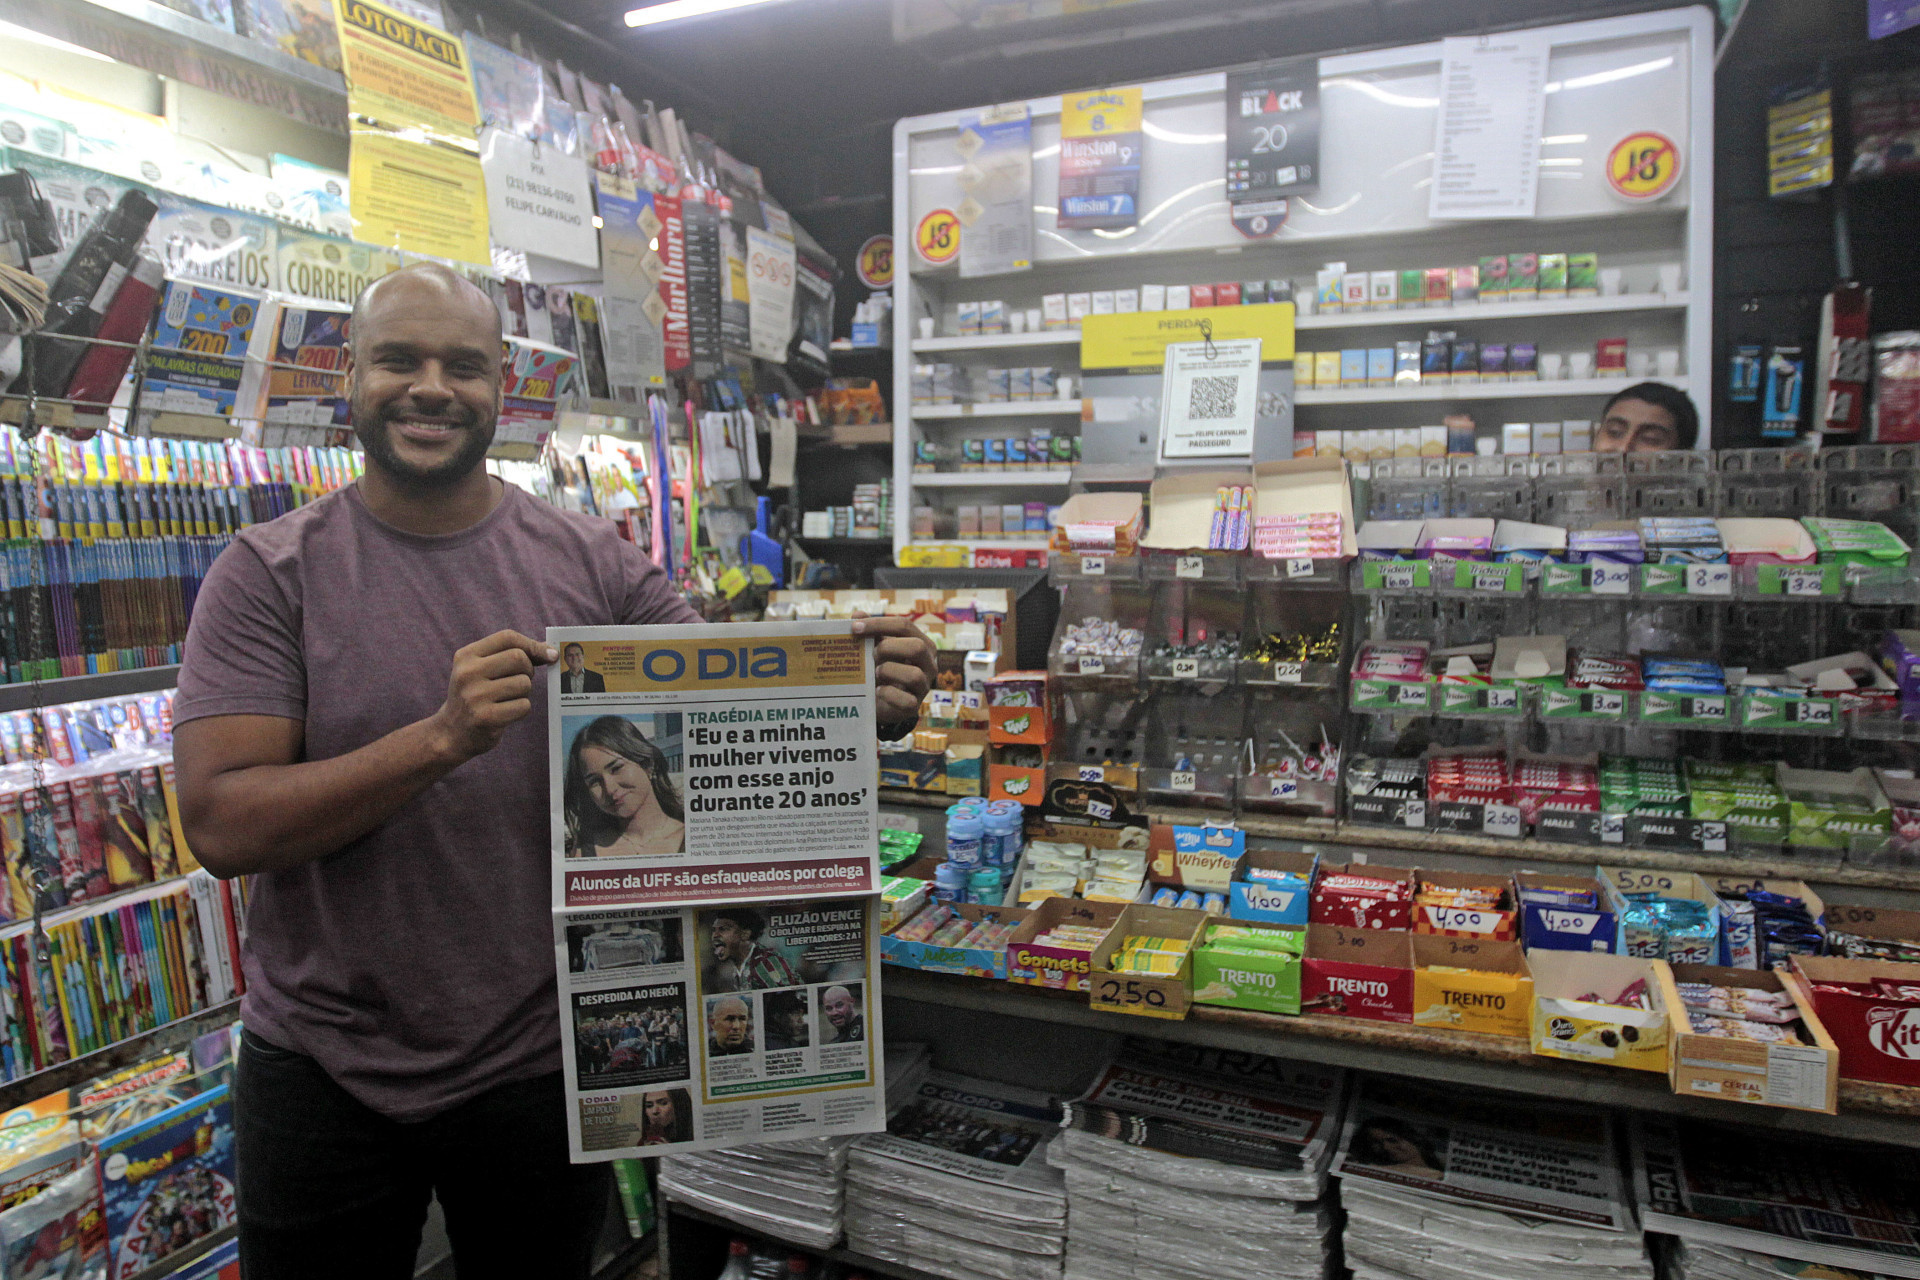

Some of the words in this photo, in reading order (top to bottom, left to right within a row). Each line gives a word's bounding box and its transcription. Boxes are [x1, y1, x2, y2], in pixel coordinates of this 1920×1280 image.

[1251, 124, 1288, 155] 20
[1061, 139, 1118, 158] Winston
[1121, 147, 1132, 165] 9
[1065, 199, 1110, 214] Winston
[1112, 194, 1125, 214] 7
[505, 196, 533, 215] FELIPE
[535, 203, 582, 227] CARVALHO
[659, 216, 688, 332] Marlboro
[151, 355, 195, 374] PALAVRAS
[196, 361, 241, 381] CRUZADAS
[1216, 428, 1247, 436] CARVALHO
[1189, 439, 1231, 448] PAGSEGURO
[1377, 563, 1418, 575] Trident
[1469, 563, 1511, 576] Trident
[1546, 571, 1578, 581] Trident
[1593, 569, 1629, 586] 8.00
[1646, 572, 1678, 581] Trident
[1694, 569, 1729, 586] 8.00
[642, 648, 686, 683] O
[1358, 687, 1388, 697] Trident
[1445, 691, 1474, 701] Trident
[1546, 695, 1577, 705] Trident
[1645, 701, 1677, 711] Trident
[688, 707, 764, 725] TRAGÉDIA
[767, 708, 789, 721] EM
[792, 706, 860, 720] IPANEMA
[1005, 717, 1030, 734] TANG
[726, 729, 738, 744] e
[743, 729, 755, 743] a
[760, 723, 826, 743] minha
[689, 748, 765, 768] mulher
[769, 746, 857, 765] vivemos
[689, 774, 733, 790] com
[737, 772, 784, 788] esse
[788, 767, 835, 788] anjo
[1004, 780, 1029, 795] TANG
[1373, 787, 1419, 799] HALLS
[690, 794, 774, 813] durante
[778, 790, 806, 809] 20
[1354, 801, 1384, 812] HALLS
[1543, 801, 1592, 812] HALLS
[1441, 809, 1472, 820] HALLS
[1633, 807, 1684, 819] HALLS
[727, 823, 766, 831] desgovernada
[1543, 818, 1576, 829] HALLS
[1726, 814, 1780, 828] HALLS
[1826, 820, 1883, 834] HALLS
[793, 828, 816, 836] Hospital
[1642, 824, 1676, 835] HALLS
[570, 876, 621, 892] Alunos
[622, 874, 642, 889] da
[643, 873, 672, 888] UFF
[674, 871, 699, 886] são
[701, 867, 792, 886] esfaqueados
[793, 868, 818, 883] por
[819, 864, 865, 880] colega
[1617, 869, 1673, 889] 5.00
[606, 911, 630, 920] DELE
[630, 908, 637, 917] É
[637, 909, 652, 917] DE
[770, 911, 820, 927] FLUZÃO
[821, 909, 862, 922] VENCE
[1436, 905, 1482, 930] 4.00
[770, 929, 777, 937] O
[777, 926, 810, 937] BOLÍVAR
[816, 924, 850, 933] RESPIRA
[850, 922, 861, 930] NA
[1250, 927, 1294, 941] TRENTO
[785, 933, 845, 946] LIBERTADORES:
[846, 933, 851, 941] 2
[852, 932, 858, 940] A
[919, 948, 966, 963] Jubes
[1017, 949, 1090, 975] Gomets
[1218, 967, 1277, 989] TRENTO
[1326, 976, 1389, 998] TRENTO
[579, 990, 634, 1006] DESPEDIDA
[634, 989, 649, 1000] AO
[649, 986, 679, 998] HERÓI
[1441, 990, 1506, 1010] TRENTO
[1550, 1018, 1574, 1030] Ouro
[1721, 1079, 1762, 1093] CEREAL
[594, 1095, 610, 1103] DIA
[1112, 1081, 1177, 1102] Crédito
[1180, 1096, 1222, 1113] para
[584, 1117, 594, 1126] DE
[595, 1115, 616, 1125] TUDO
